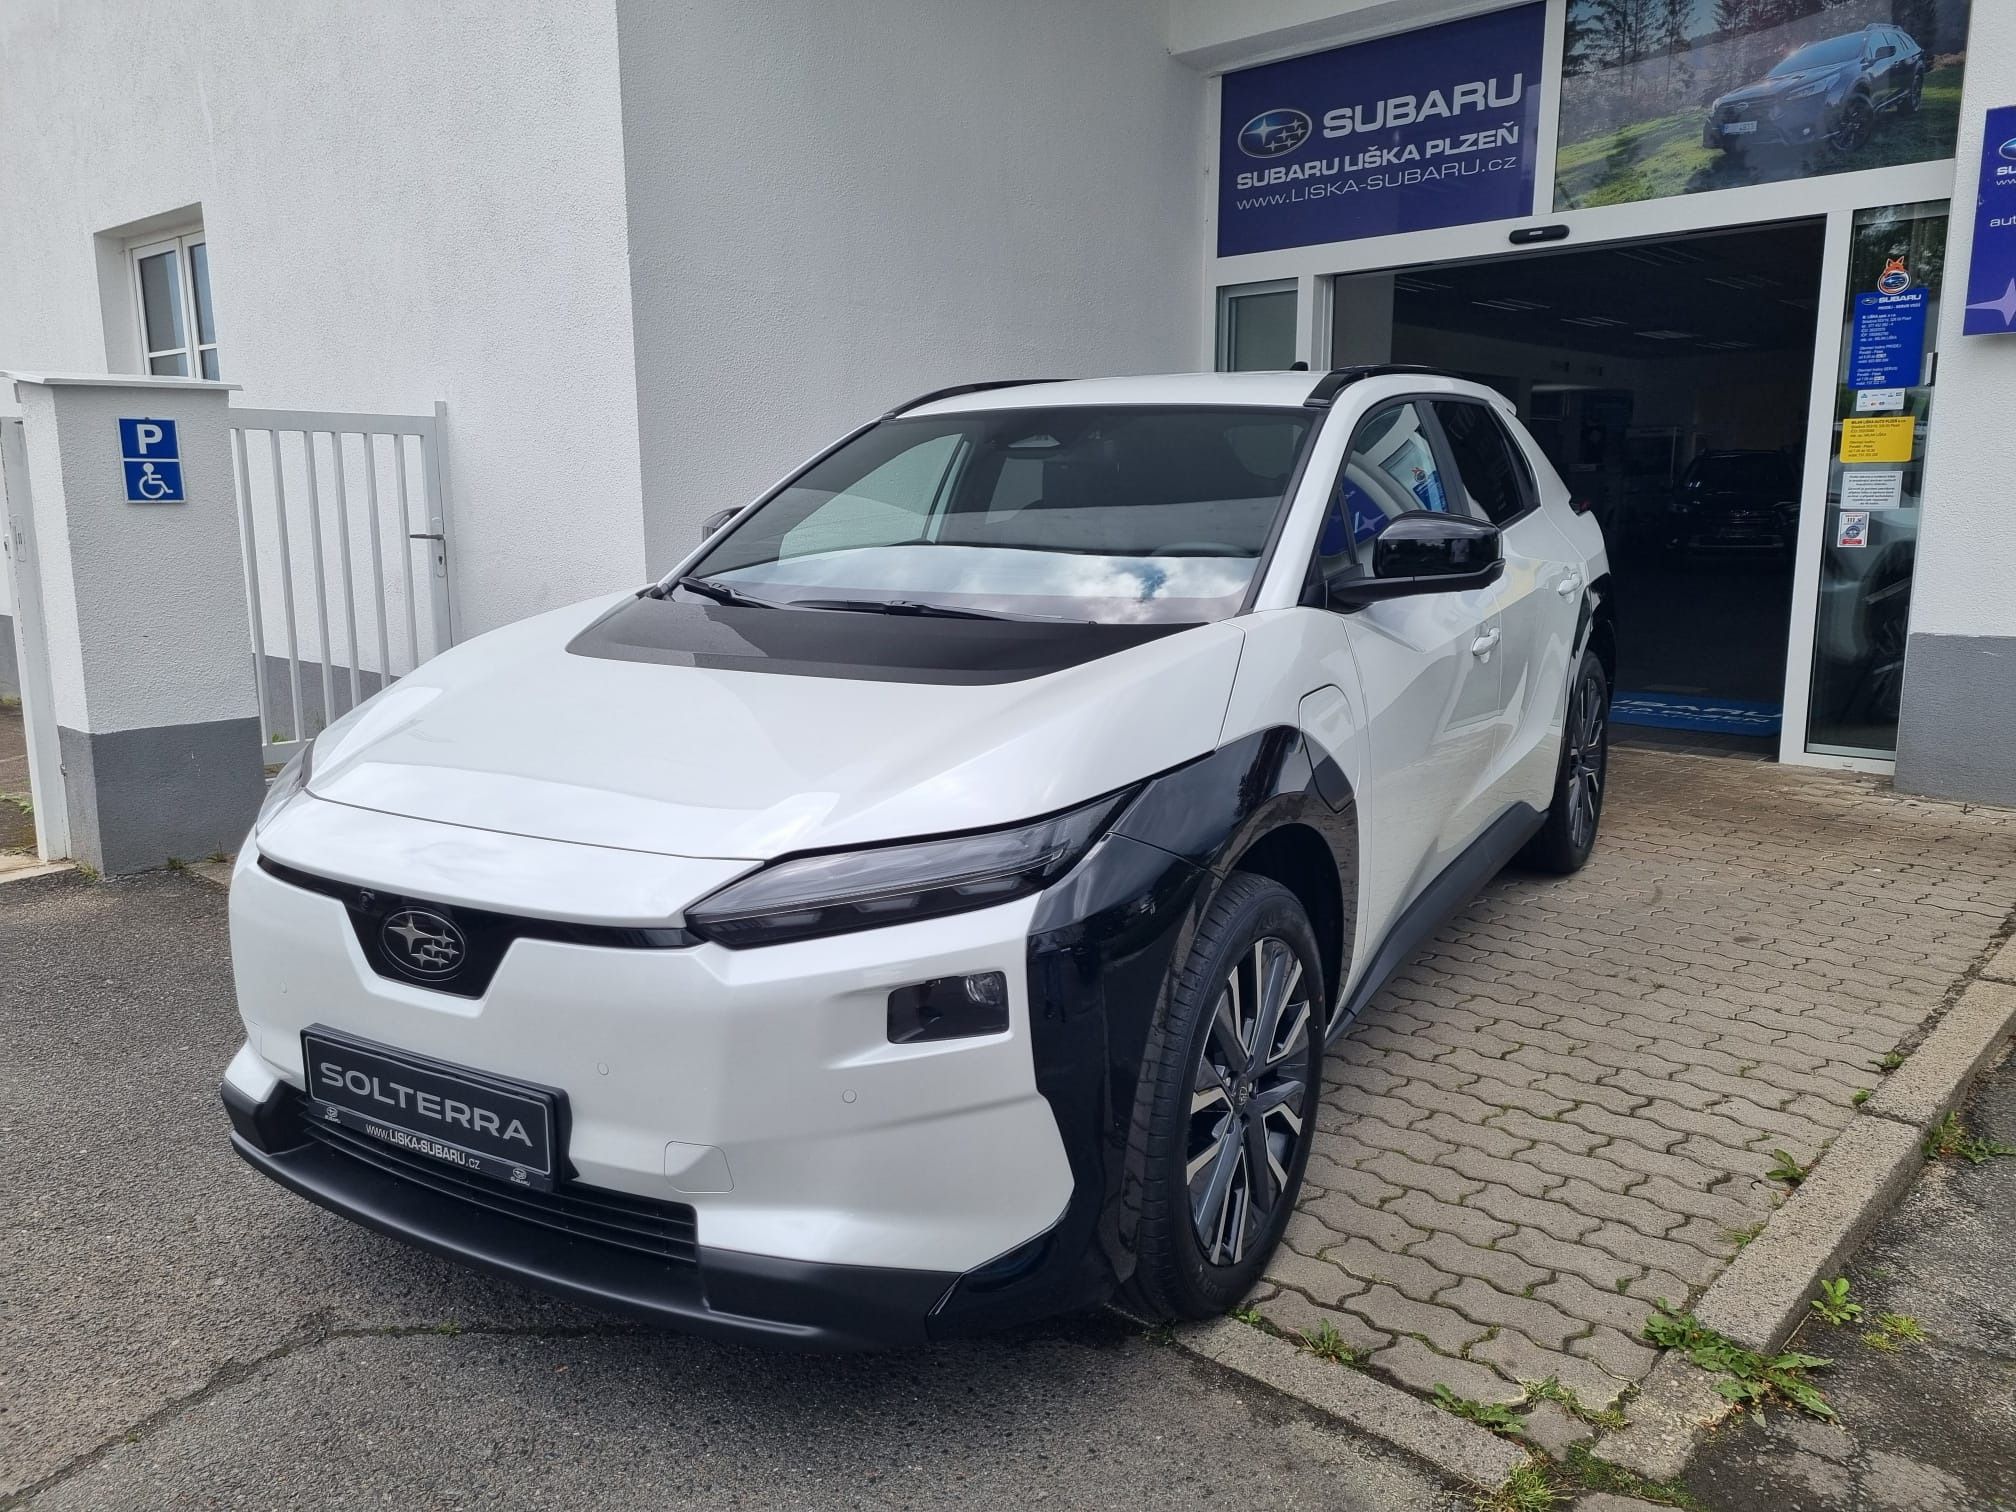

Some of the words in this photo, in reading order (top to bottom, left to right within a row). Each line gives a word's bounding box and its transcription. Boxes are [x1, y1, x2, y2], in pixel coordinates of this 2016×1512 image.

[1322, 73, 1523, 139] SUBARU
[1236, 157, 1340, 190] SUBARU
[1343, 146, 1420, 172] LIŠKA
[1425, 121, 1519, 158] PLZEŇ
[1236, 156, 1518, 210] www.LISKA-SUBARU.cz
[1878, 294, 1922, 304] SUBARU
[136, 424, 163, 454] P
[320, 1062, 533, 1147] SOLTERRA
[365, 1123, 481, 1171] www.LISKA-SUBARU.cz
